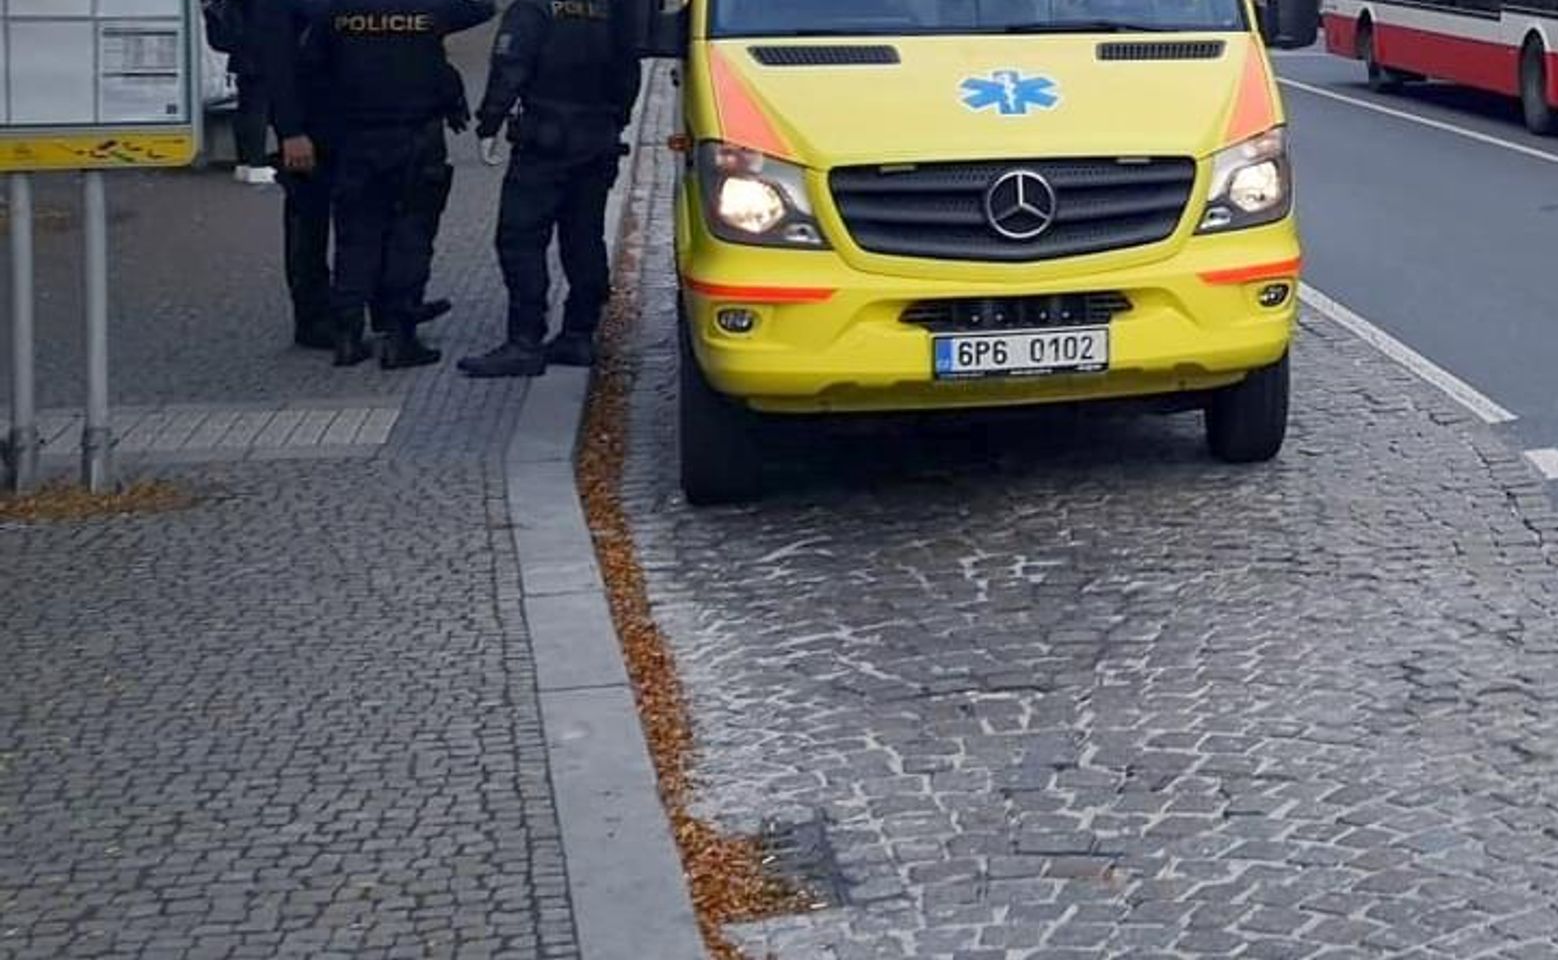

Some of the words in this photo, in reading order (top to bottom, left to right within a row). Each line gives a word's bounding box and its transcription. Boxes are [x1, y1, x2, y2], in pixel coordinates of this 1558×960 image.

[335, 14, 433, 31] POLICIE
[958, 340, 1008, 367] 6P6
[1029, 337, 1094, 363] 0102
